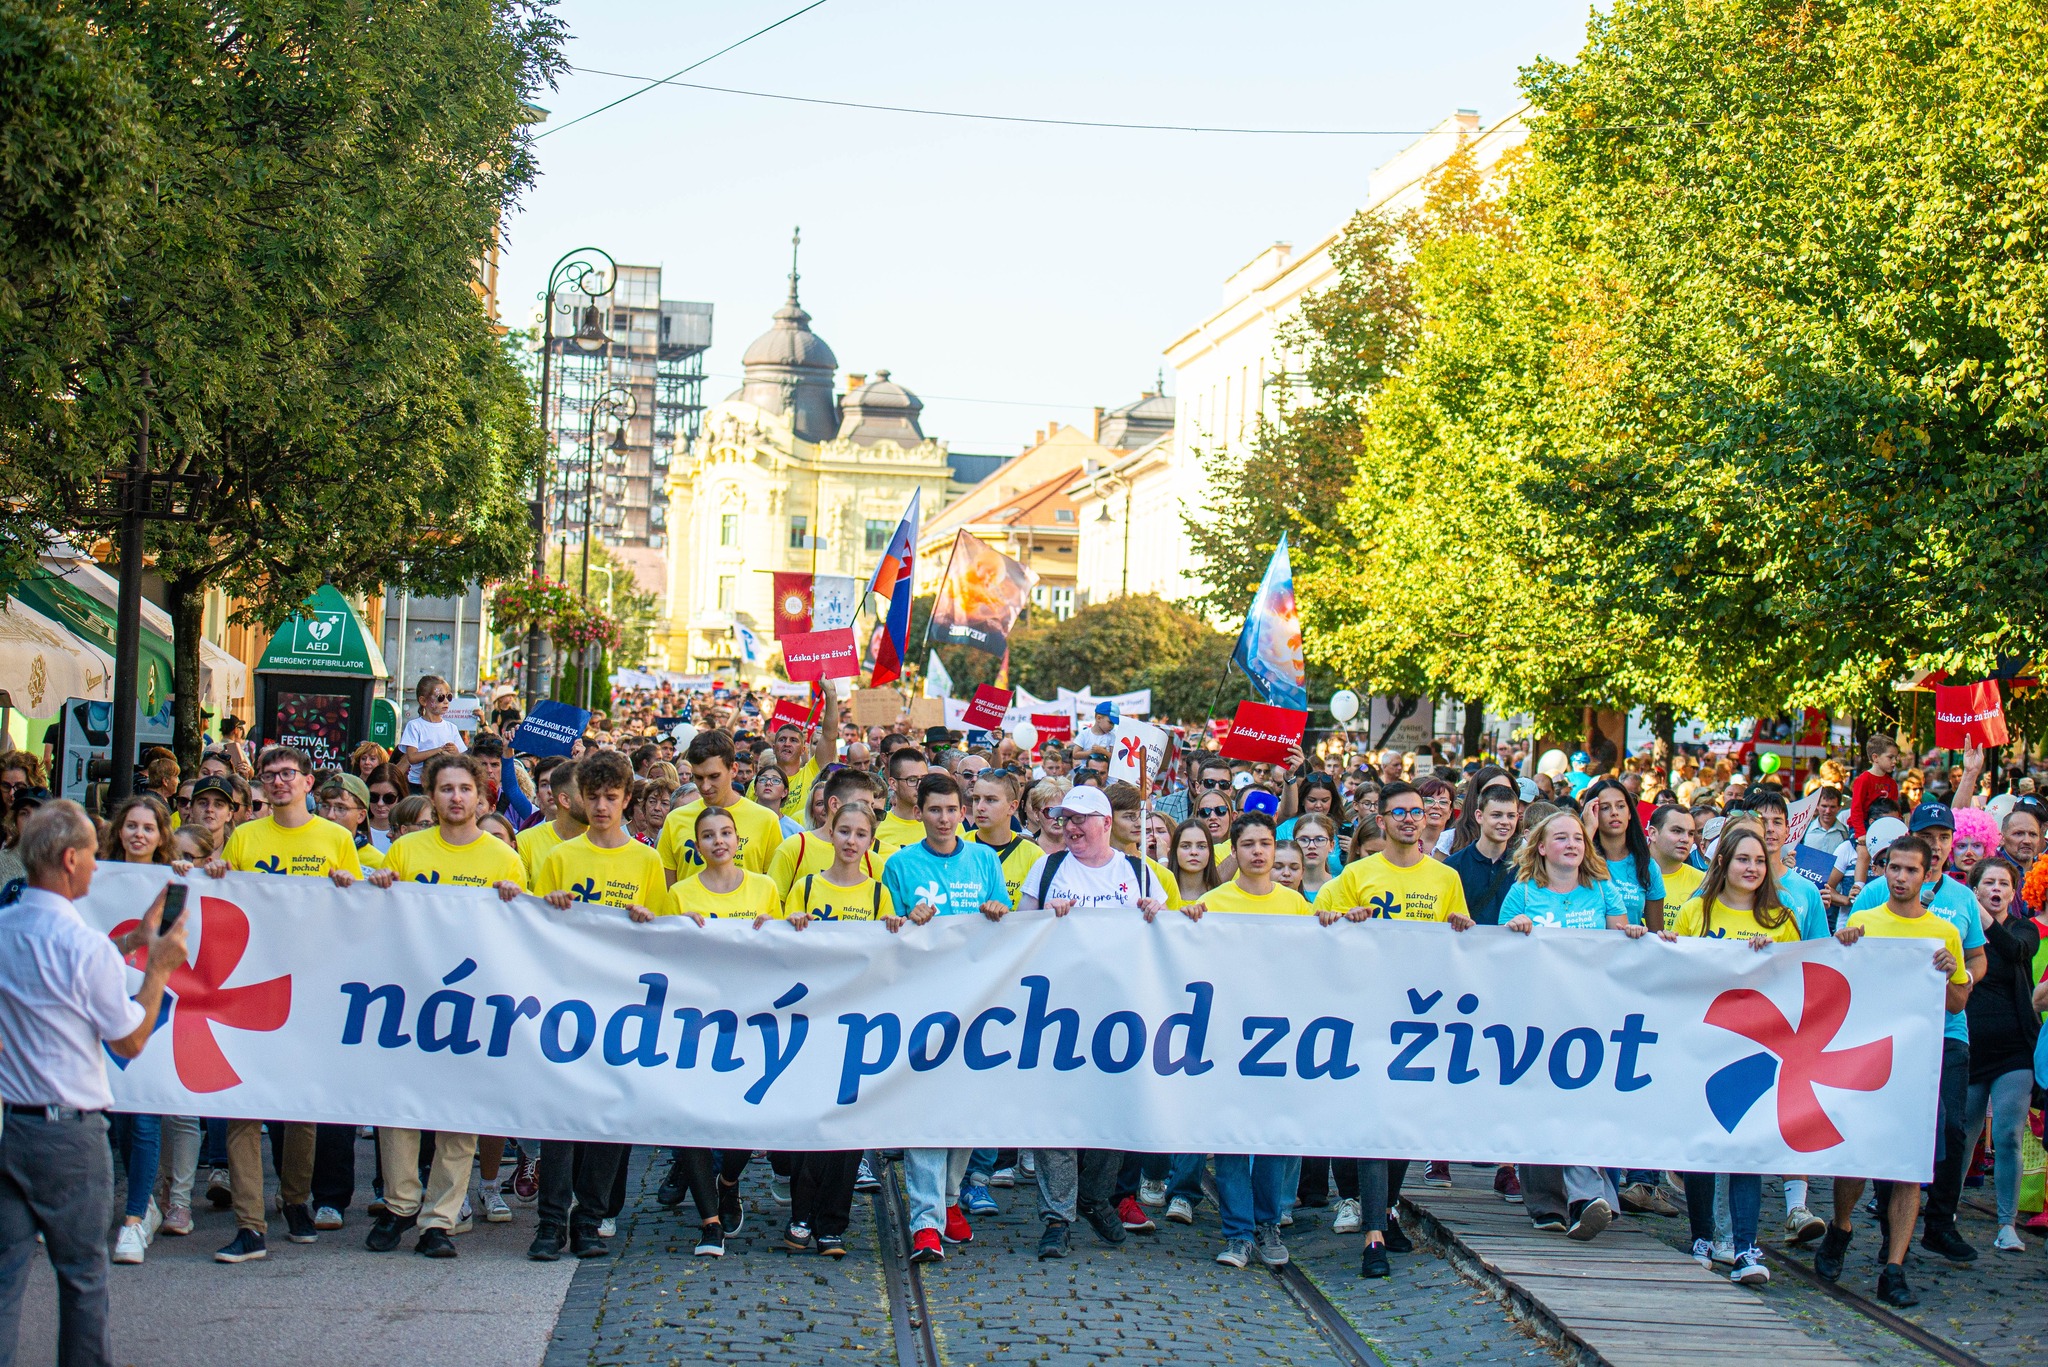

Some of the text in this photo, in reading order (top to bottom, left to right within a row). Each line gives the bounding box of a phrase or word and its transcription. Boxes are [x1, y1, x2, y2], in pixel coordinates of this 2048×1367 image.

[306, 642, 329, 651] AED
[269, 656, 364, 668] EMERGENCY DEFIBRILLATOR
[788, 653, 812, 662] Láska
[811, 652, 820, 663] je
[1937, 711, 1962, 723] Láska
[1961, 713, 1973, 725] je
[1973, 713, 1984, 722] za
[535, 718, 561, 731] HLASOM
[560, 725, 578, 737] TÝCH,
[531, 726, 548, 736] HLAS
[547, 731, 573, 743] NEMAJÚ
[1233, 726, 1259, 738] Láska
[1255, 731, 1267, 741] je
[1266, 734, 1277, 742] za
[281, 735, 330, 748] FESTIVAL
[313, 746, 337, 760] ČAJ
[292, 855, 326, 865] národný
[291, 864, 320, 873] pochod
[452, 874, 488, 886] národný
[1799, 867, 1823, 884] TÝCH,
[606, 880, 640, 893] národný
[950, 881, 983, 892] národný
[605, 890, 634, 900] pochod
[950, 889, 978, 899] pochod
[1405, 892, 1438, 903] národný
[614, 900, 627, 908] živ
[1405, 901, 1433, 910] pochod
[728, 910, 757, 919] národný
[842, 906, 872, 917] národný
[1565, 908, 1595, 918] národný
[340, 957, 1659, 1105] národný pochod za život
